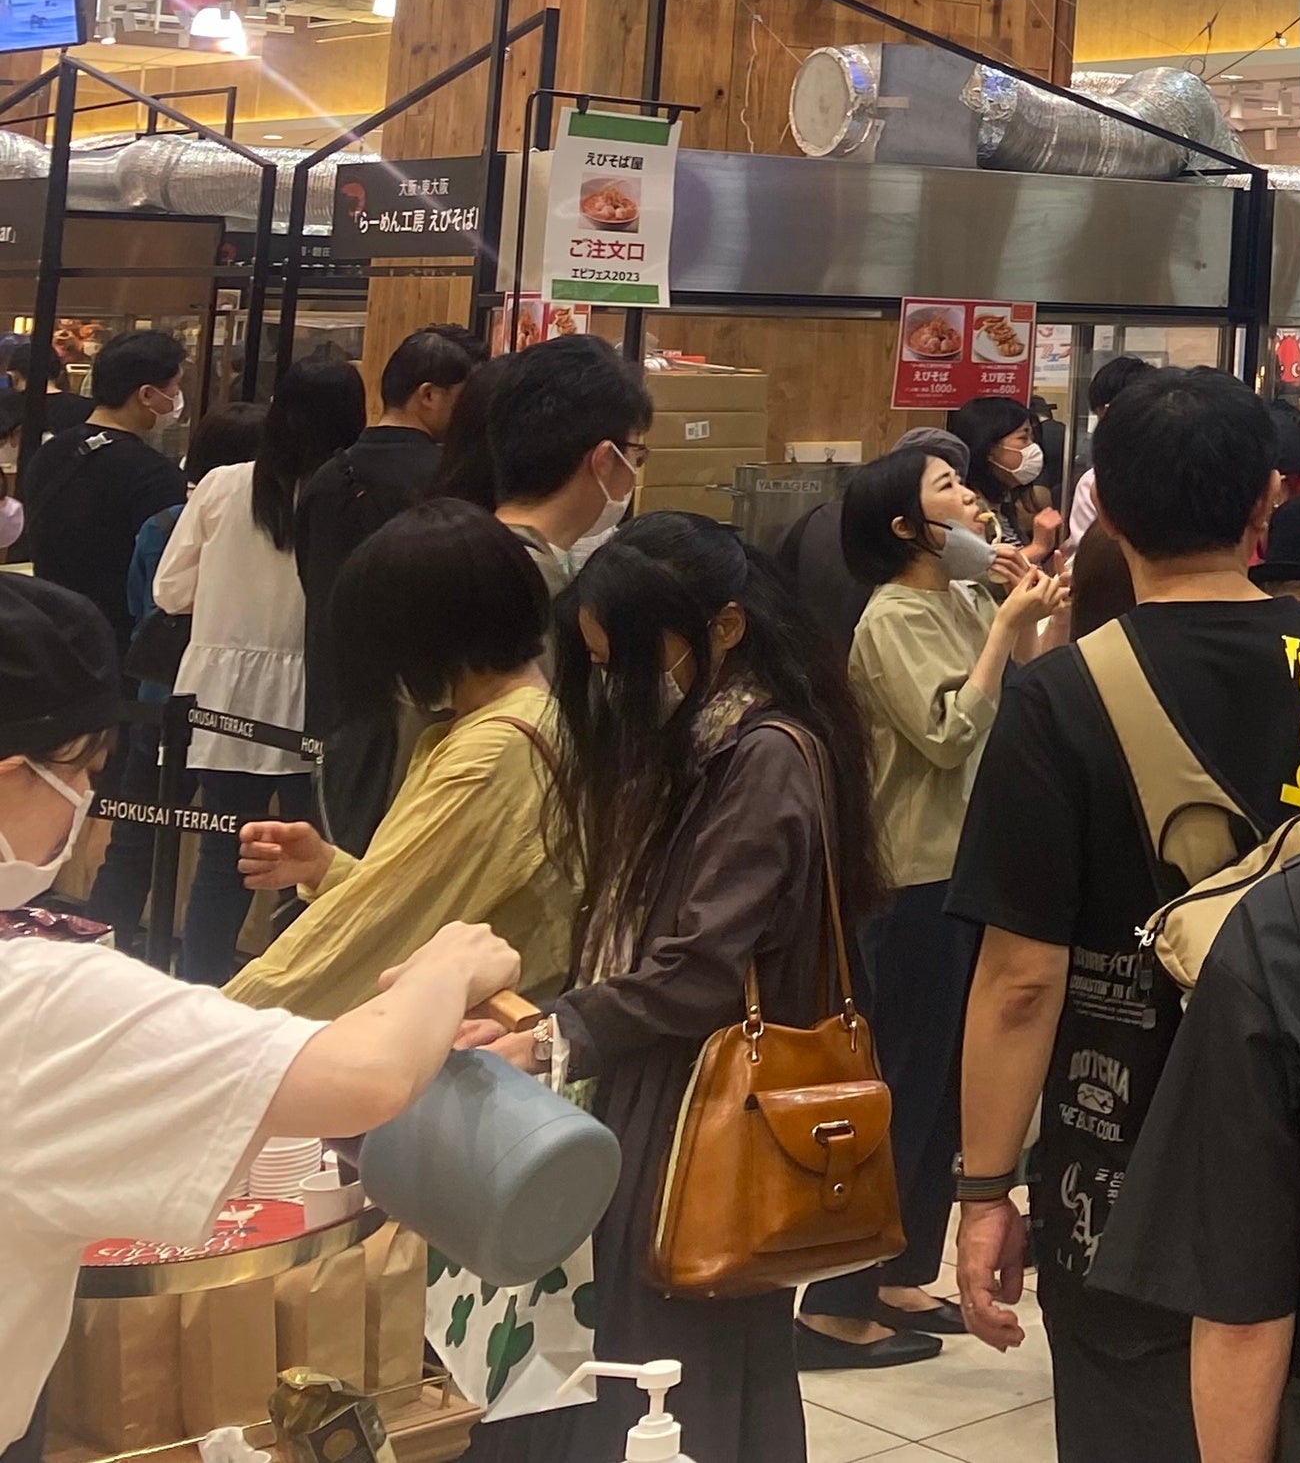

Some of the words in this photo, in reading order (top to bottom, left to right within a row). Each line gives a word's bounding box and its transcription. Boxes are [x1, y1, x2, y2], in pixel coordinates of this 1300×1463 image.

[584, 152, 644, 170] えびそば屋
[398, 178, 450, 196] 大阪・東大阪
[569, 238, 645, 261] ご注文口
[571, 268, 641, 282] エビフェス2023
[912, 370, 950, 382] えびそば
[187, 708, 218, 728] OKUSAI
[219, 715, 255, 738] TERRACE
[99, 799, 169, 826] SHOKUSAI
[174, 809, 237, 834] TERRACE
[1096, 1119, 1125, 1143] COOL
[1094, 1167, 1111, 1182] IN
